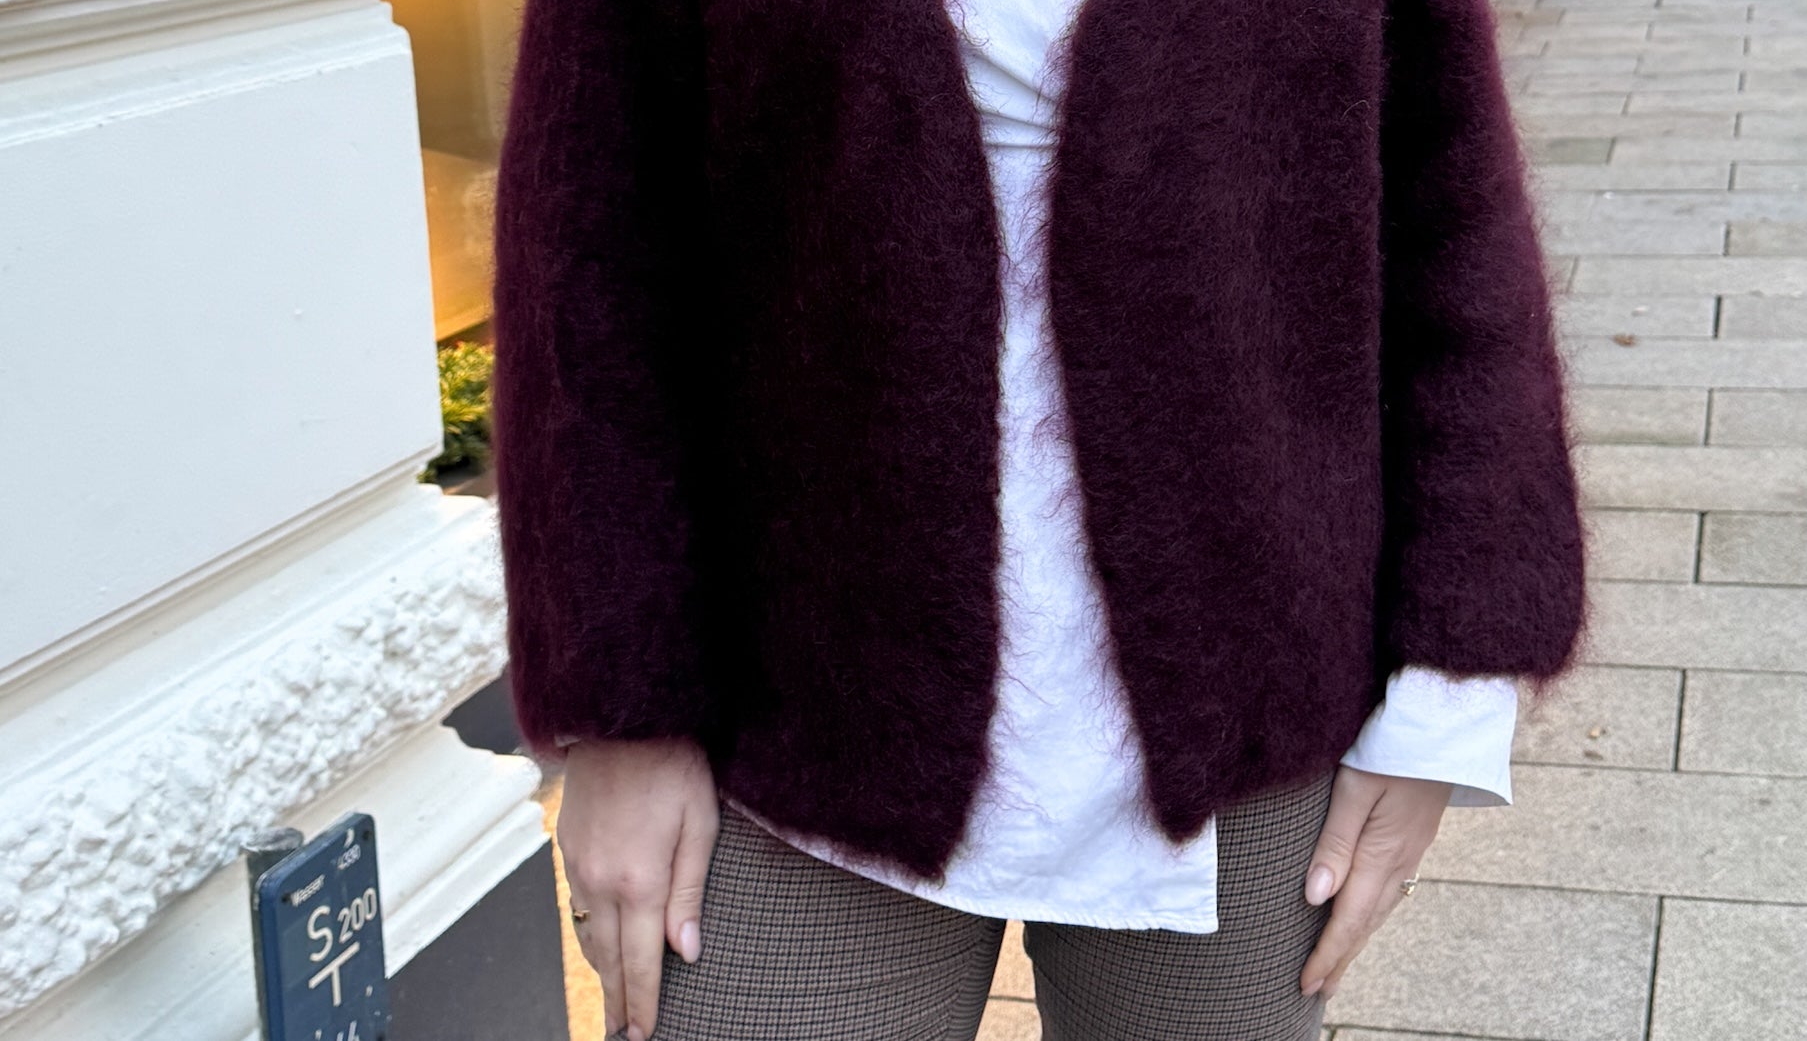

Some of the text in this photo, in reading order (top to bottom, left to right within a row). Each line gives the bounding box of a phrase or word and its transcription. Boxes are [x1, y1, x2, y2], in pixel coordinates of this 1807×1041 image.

[307, 887, 377, 962] S 200
[308, 941, 360, 1007] T
